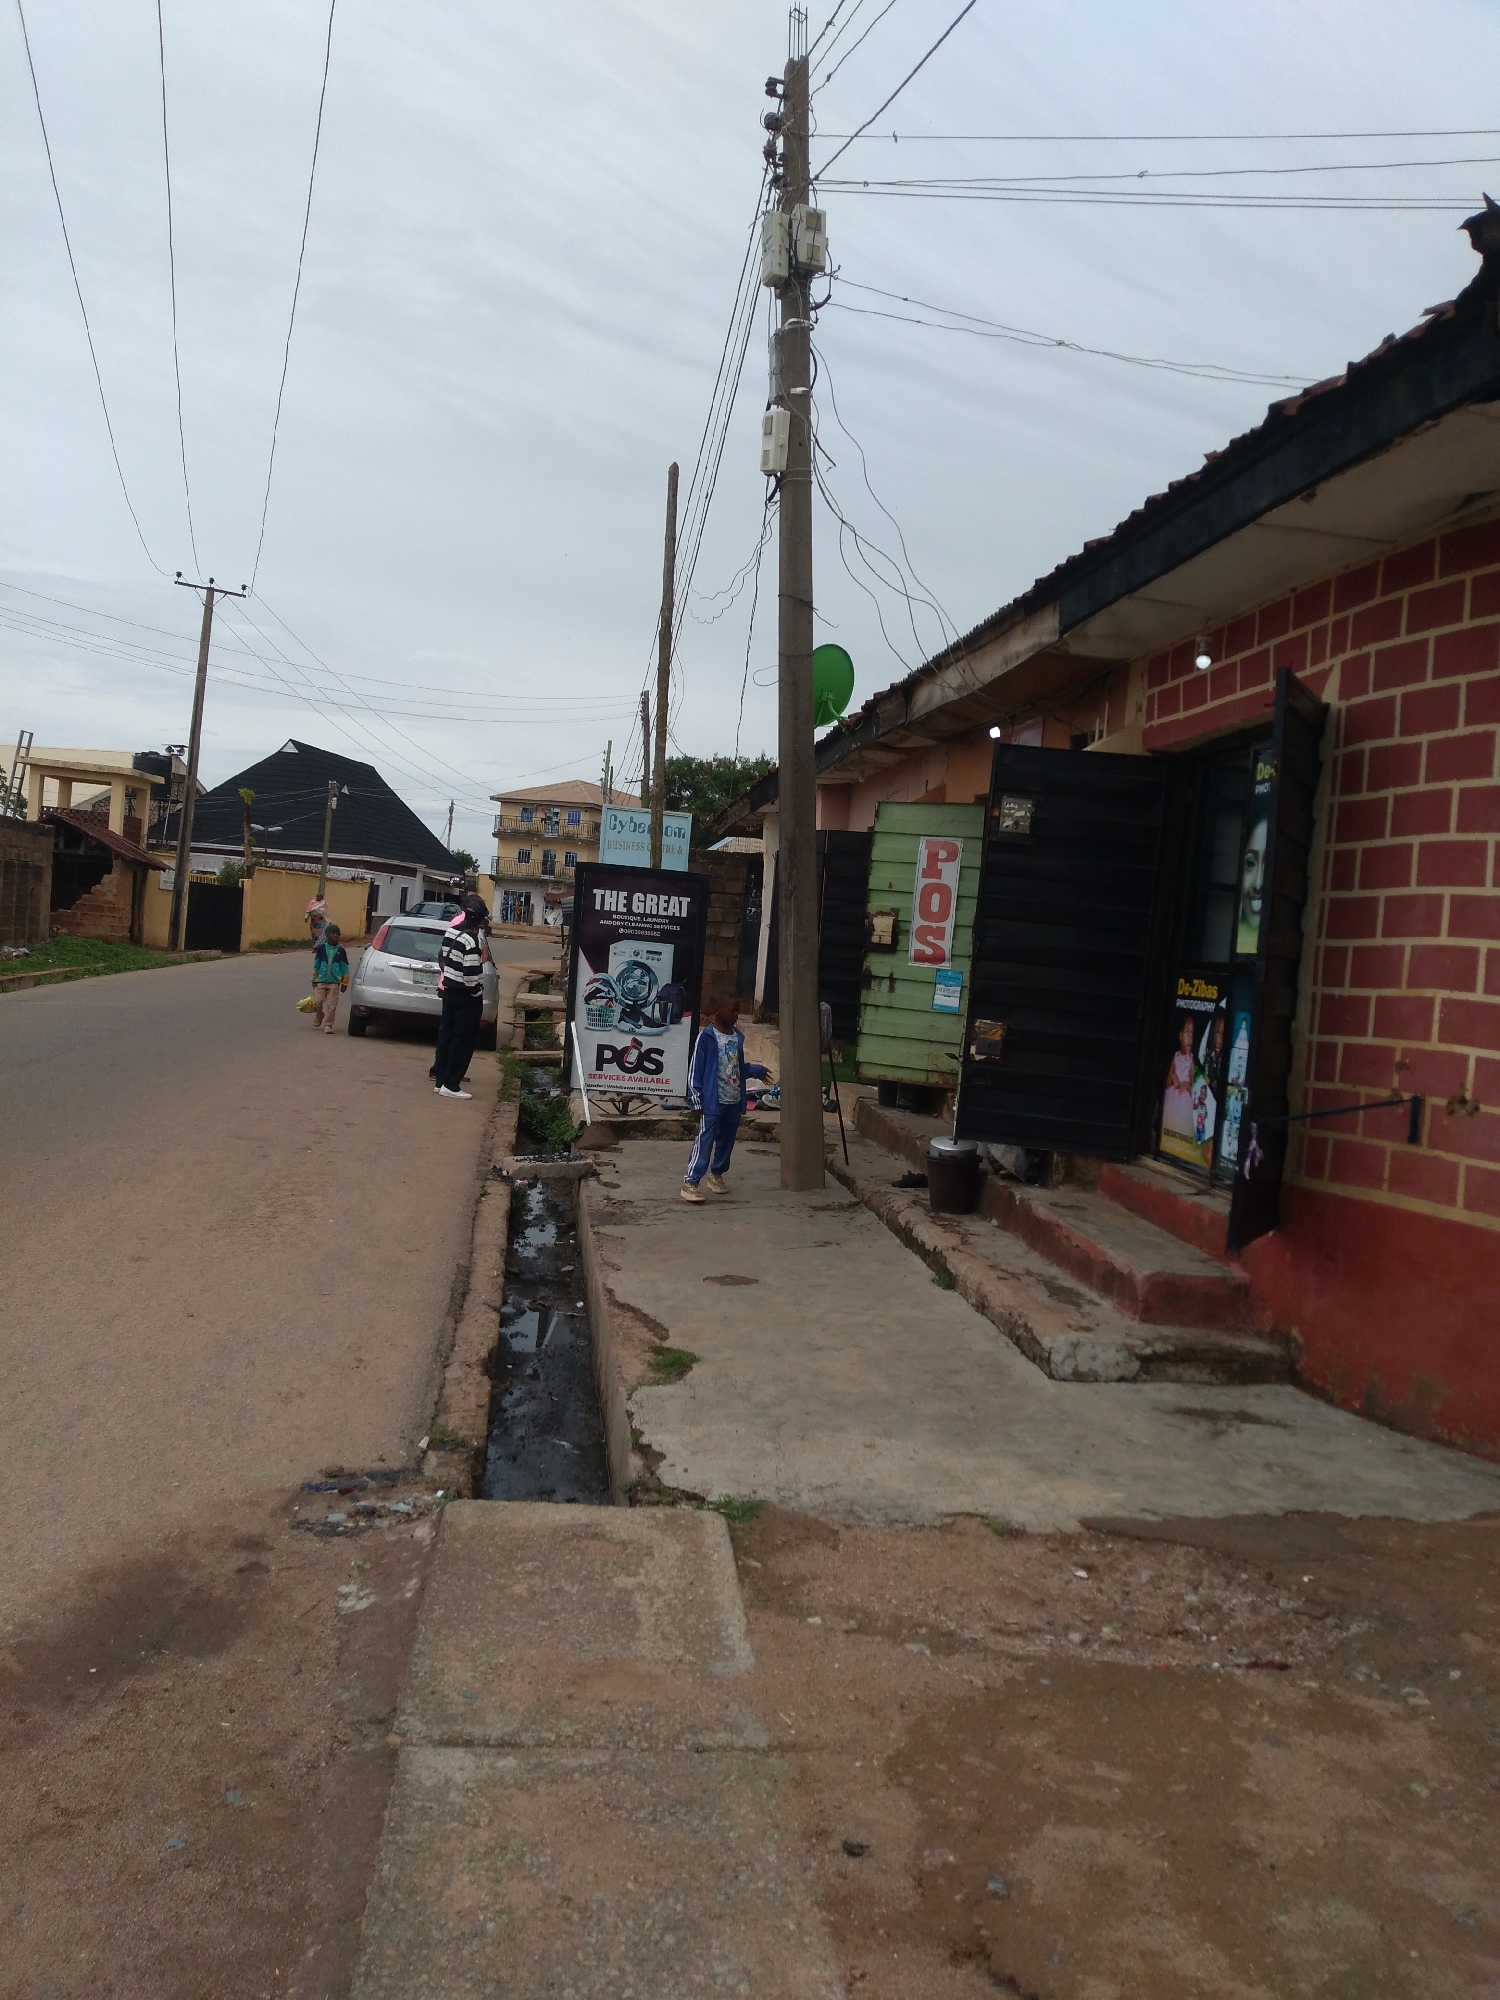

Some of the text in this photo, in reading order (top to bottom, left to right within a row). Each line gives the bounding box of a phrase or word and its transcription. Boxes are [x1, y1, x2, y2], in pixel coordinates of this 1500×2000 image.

[607, 839, 684, 855] BUSINESS CTRE &
[593, 888, 628, 913] THE
[631, 892, 691, 918] GREAT
[913, 839, 959, 965] POS
[643, 916, 670, 924] LAUNDRY
[1177, 977, 1218, 999] De-Zibas
[595, 1043, 665, 1075] POS
[588, 1072, 671, 1085] SERVICES AVAILABLE
